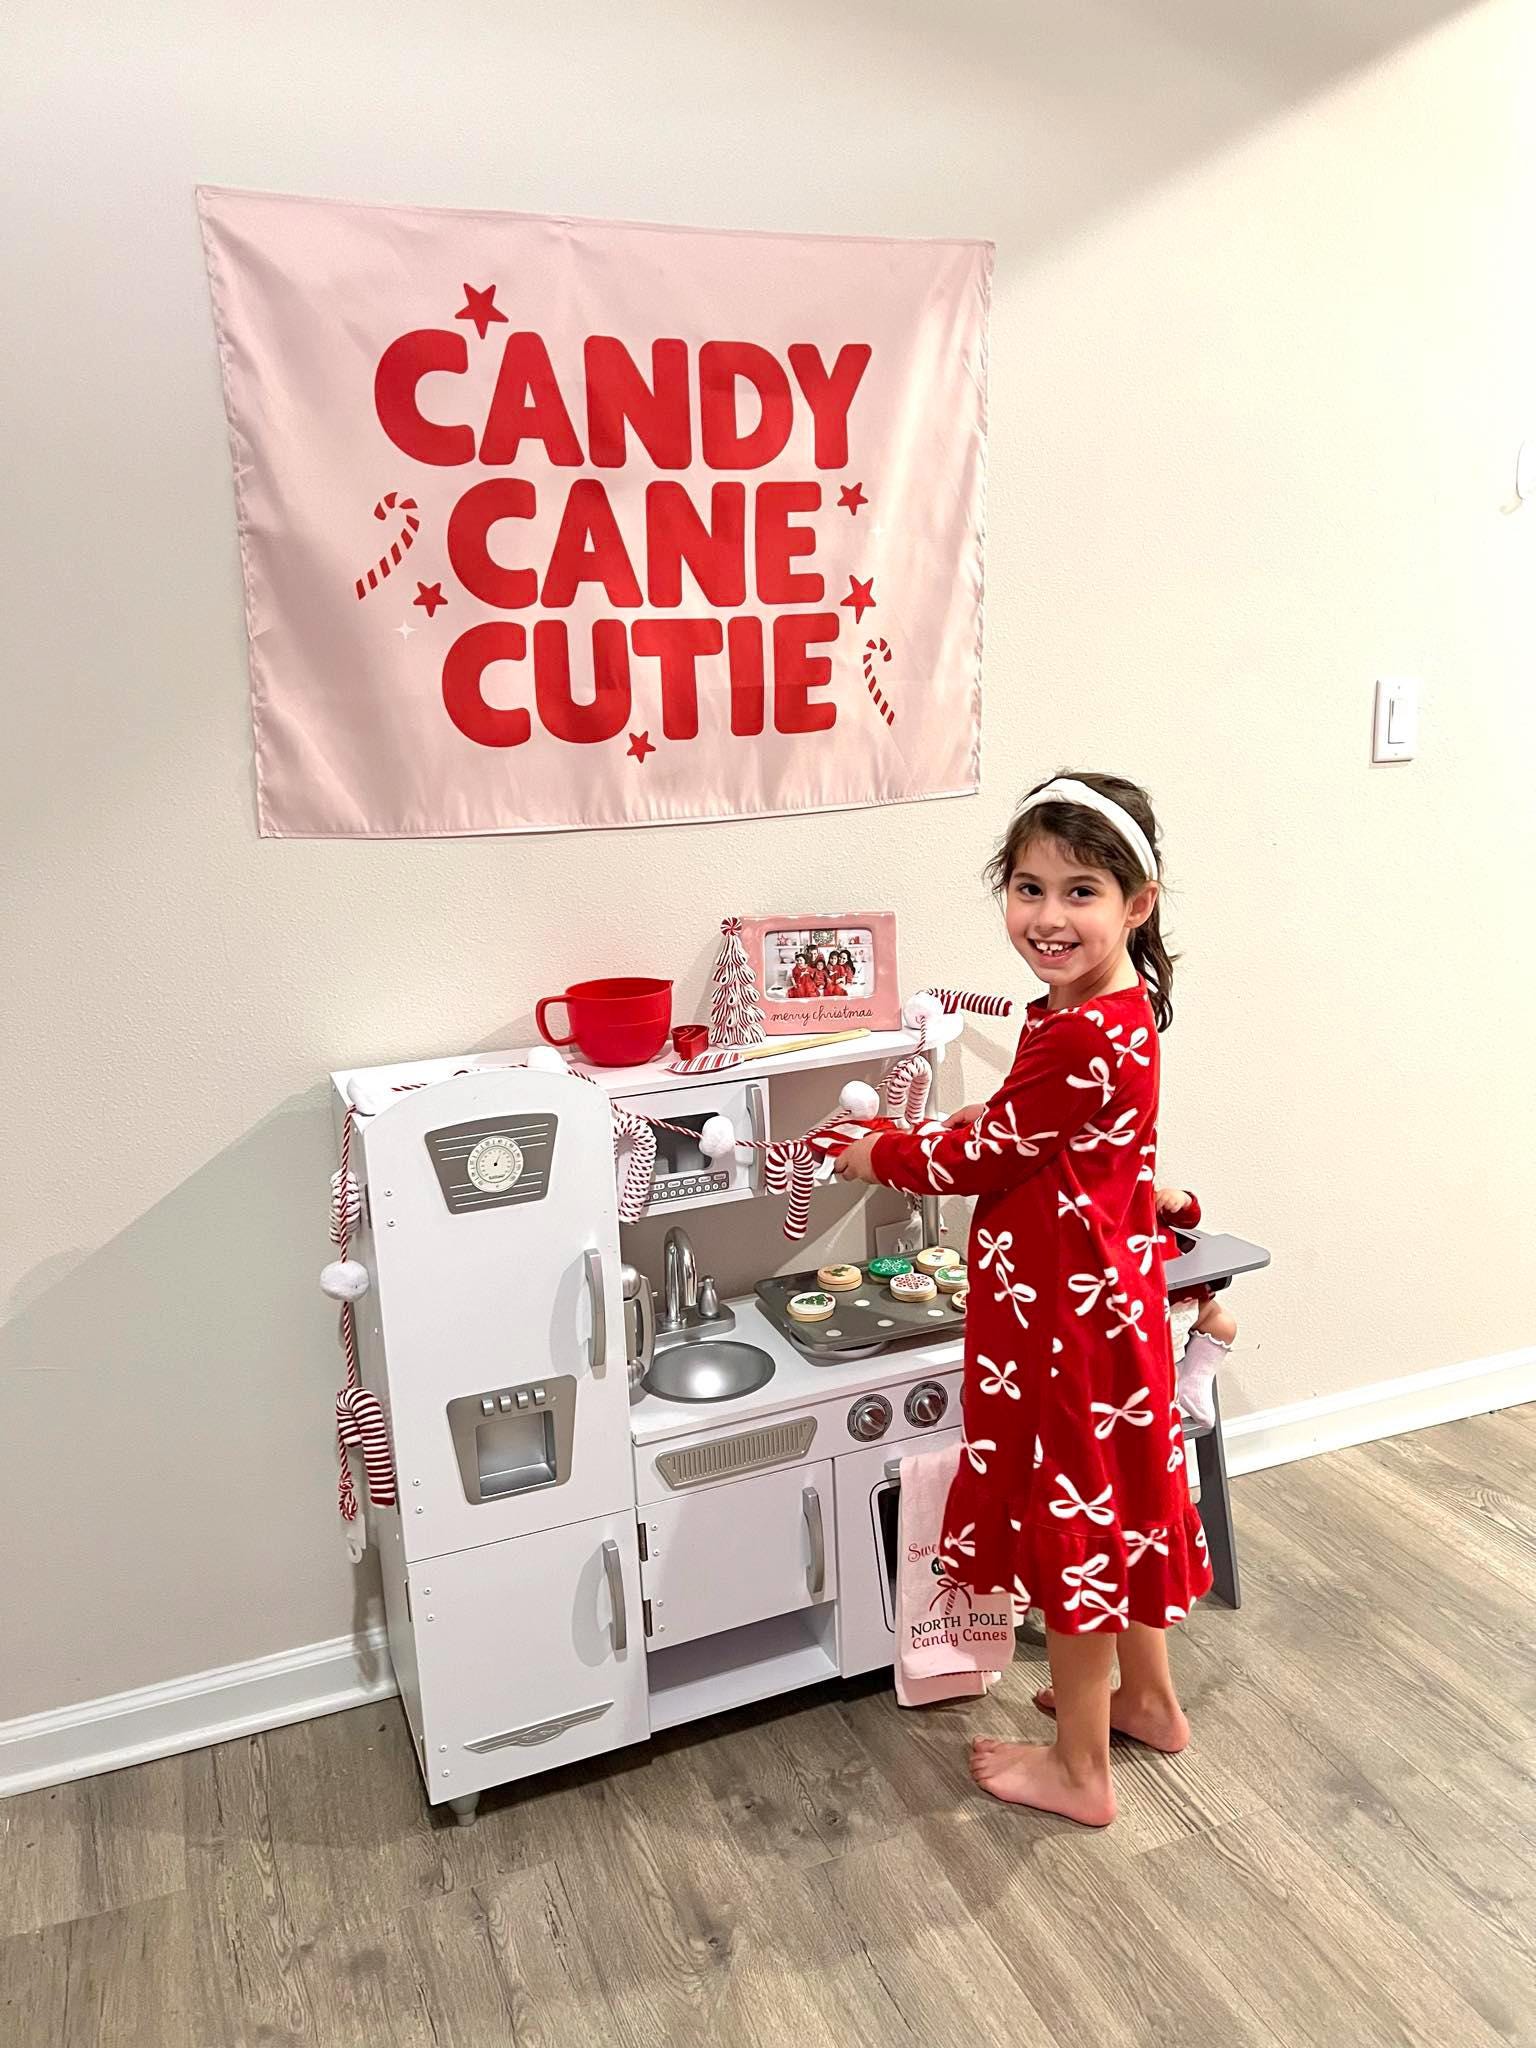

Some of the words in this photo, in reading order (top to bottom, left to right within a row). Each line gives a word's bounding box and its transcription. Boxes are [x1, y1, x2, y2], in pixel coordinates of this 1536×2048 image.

[375, 329, 872, 471] CANDY
[447, 478, 825, 610] CANE
[442, 613, 840, 748] CUTIE
[771, 1012, 810, 1026] merry
[812, 1005, 873, 1021] christmas
[907, 1542, 937, 1563] Swe
[911, 1616, 961, 1638] NORTH
[968, 1613, 1008, 1627] POLE
[912, 1630, 959, 1649] Candy
[962, 1628, 1008, 1642] Canes
